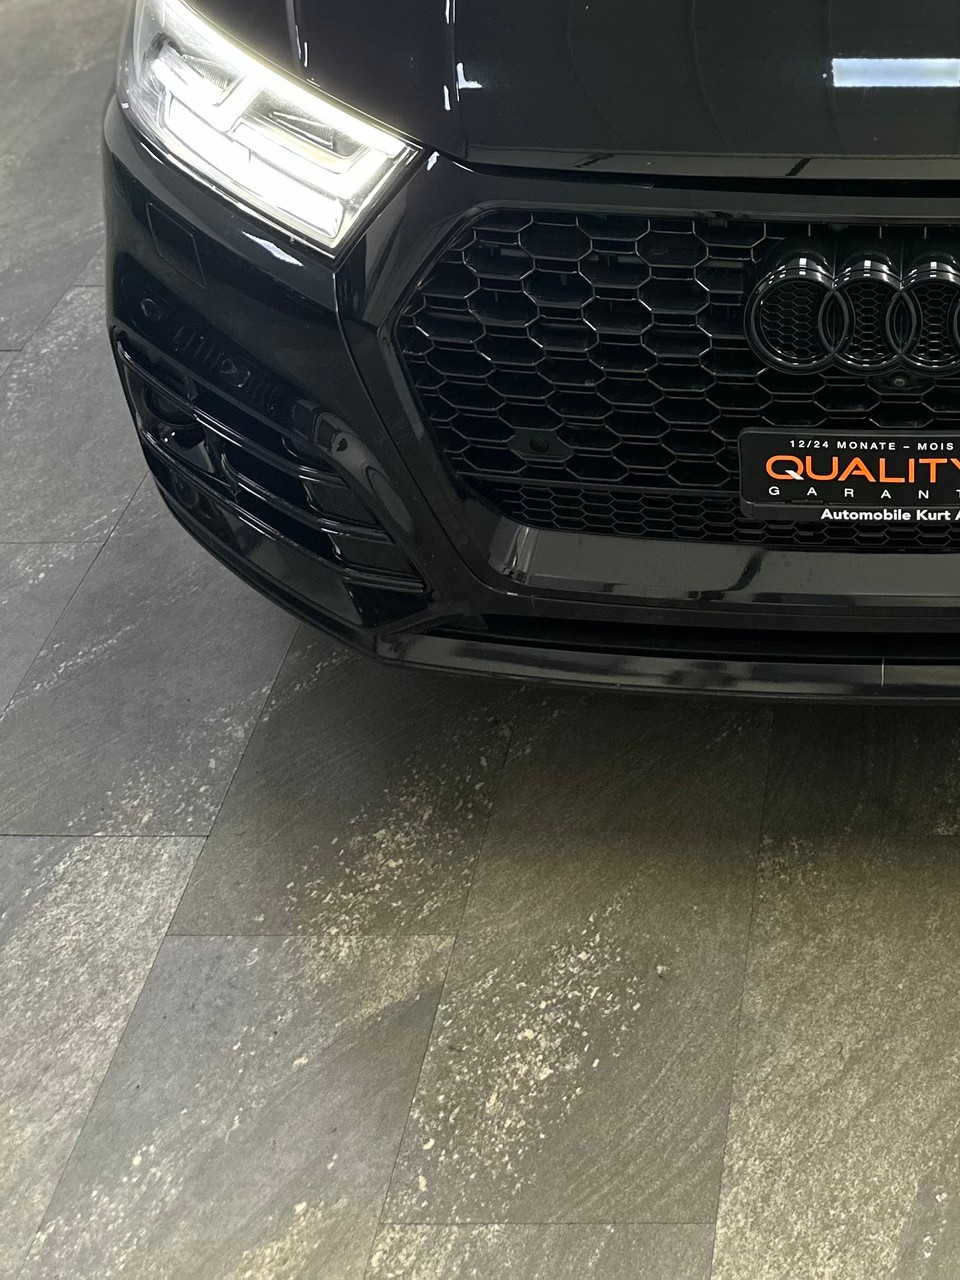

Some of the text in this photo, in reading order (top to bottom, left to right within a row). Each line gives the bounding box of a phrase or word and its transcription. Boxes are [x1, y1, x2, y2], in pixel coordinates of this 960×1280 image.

[790, 440, 829, 448] 12/24
[837, 441, 896, 450] MONATE
[918, 442, 954, 451] MOIS
[821, 508, 911, 521] Automobile
[917, 509, 951, 521] Kurt
